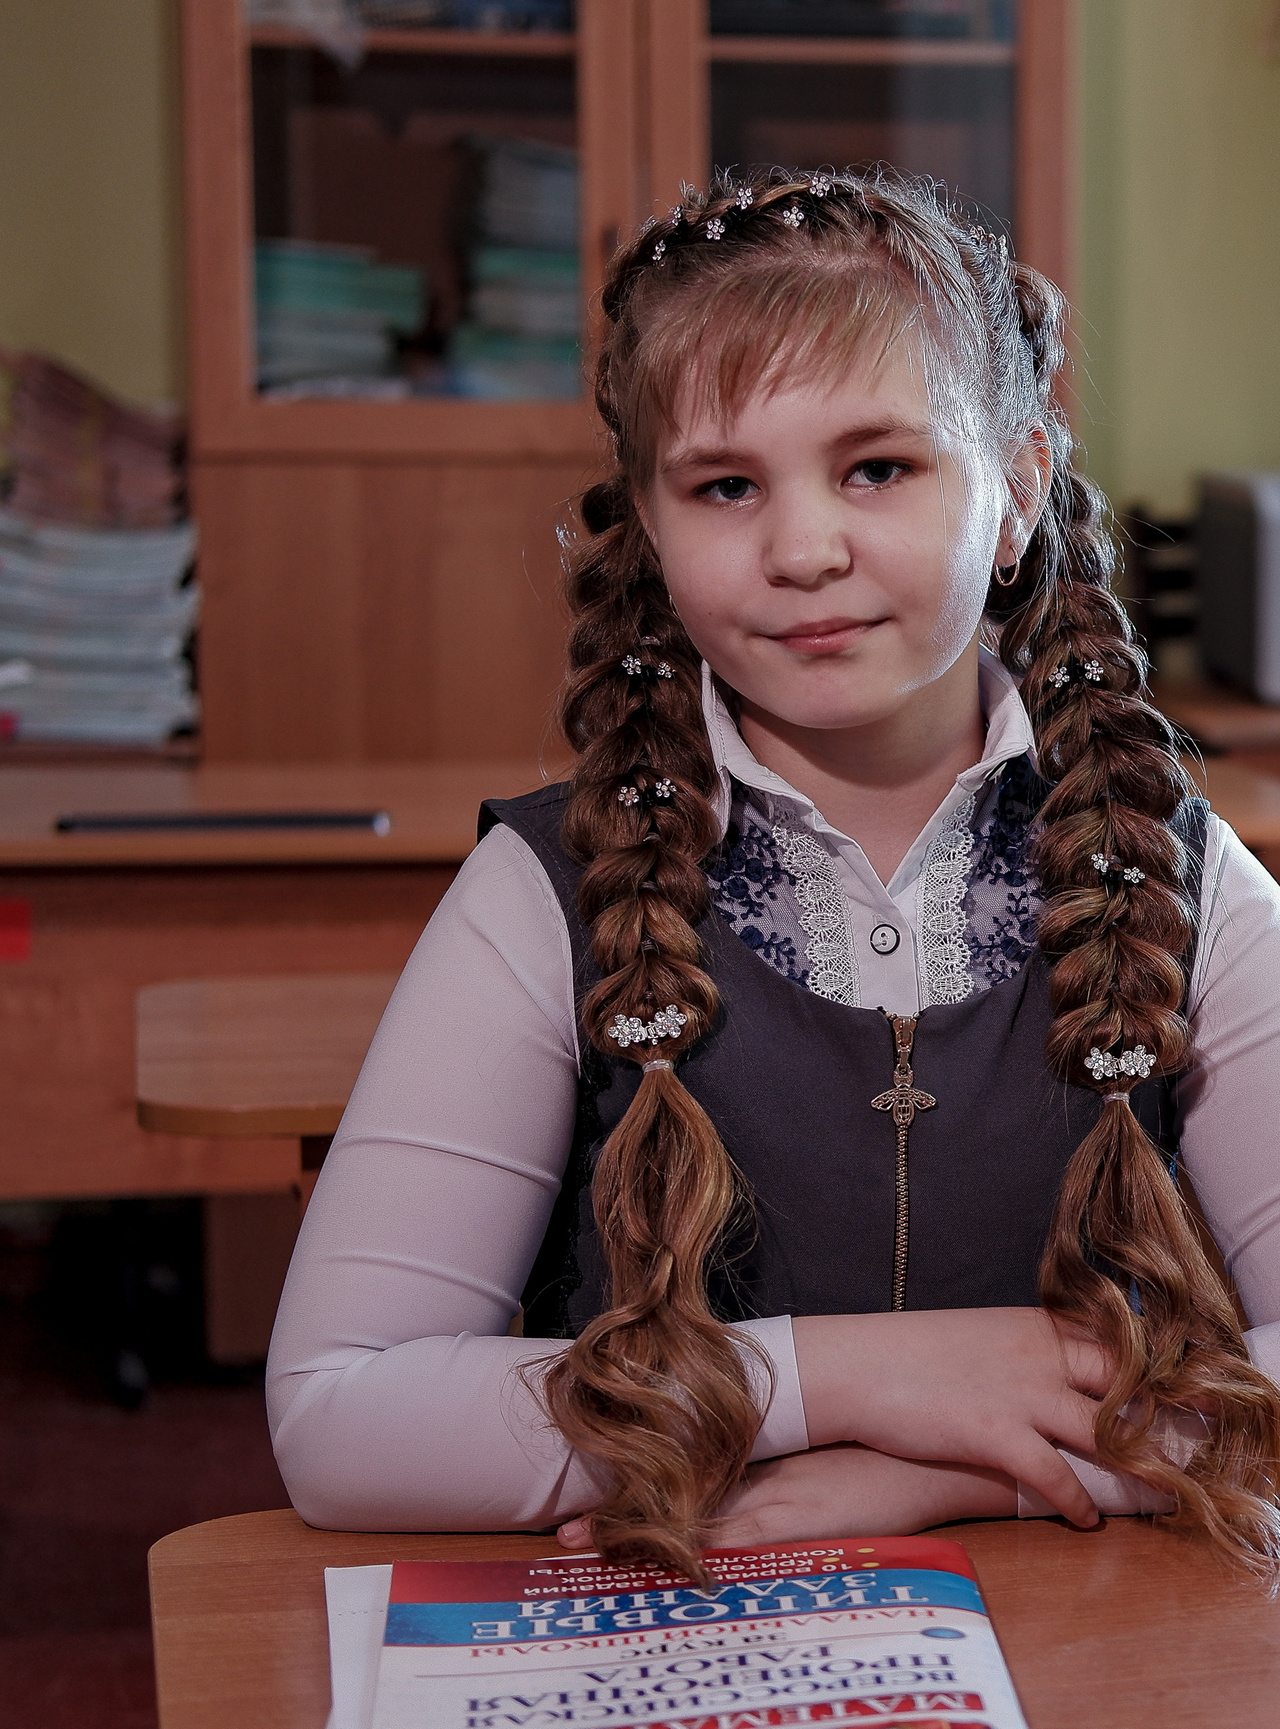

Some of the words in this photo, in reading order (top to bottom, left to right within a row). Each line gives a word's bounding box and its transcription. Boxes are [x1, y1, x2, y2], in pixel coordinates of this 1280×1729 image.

[561, 1570, 666, 1584] оценок
[703, 1559, 814, 1573] Критер
[820, 1563, 853, 1573] 10
[516, 1572, 877, 1618] ЗАДАНИЯ
[523, 1580, 647, 1597] заданий
[471, 1585, 930, 1640] ТИПОВЫЕ
[663, 1608, 937, 1642] НАЧАЛЬНОЙ
[471, 1634, 648, 1658] ШКОЛЫ
[620, 1638, 726, 1659] курс
[743, 1631, 788, 1644] за
[582, 1644, 833, 1684] РАБОТА
[465, 1653, 954, 1712] ПРОВЕРОЧНАЯ
[465, 1670, 958, 1728] ВСЕРОССИЙСКАЯ
[633, 1692, 969, 1729] МАТЕМА
